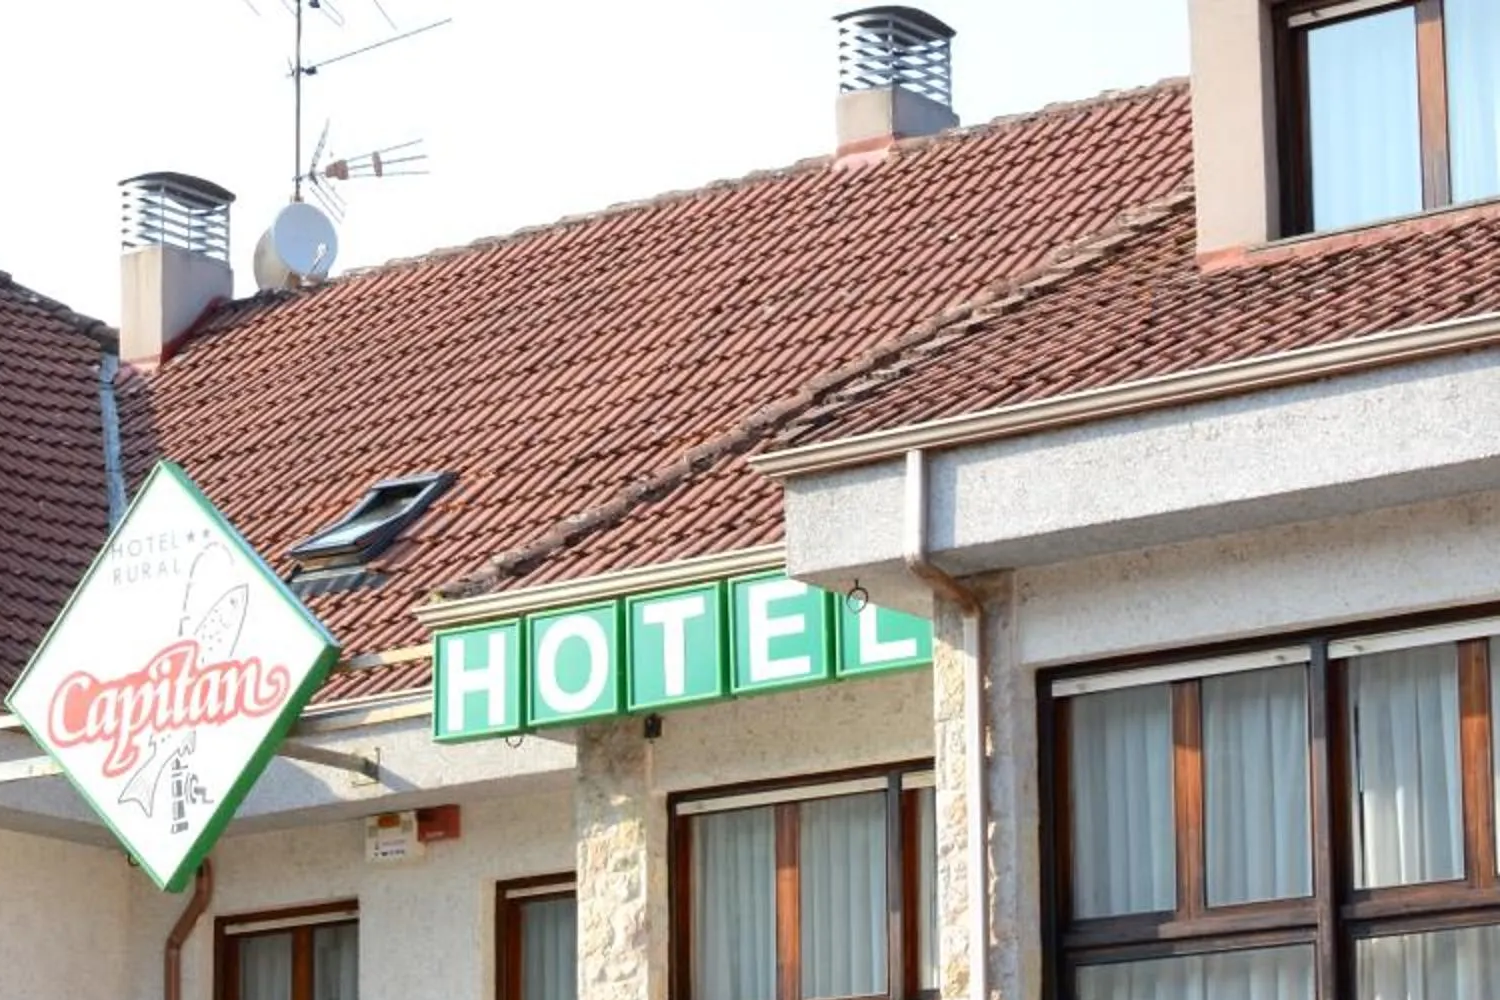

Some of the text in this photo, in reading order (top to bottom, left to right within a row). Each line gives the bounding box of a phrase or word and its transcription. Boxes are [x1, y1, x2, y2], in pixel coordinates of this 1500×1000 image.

[111, 529, 180, 562] HOTEL
[112, 557, 182, 586] RURAL
[446, 578, 917, 731] HOTEL
[48, 639, 289, 777] Capitan
